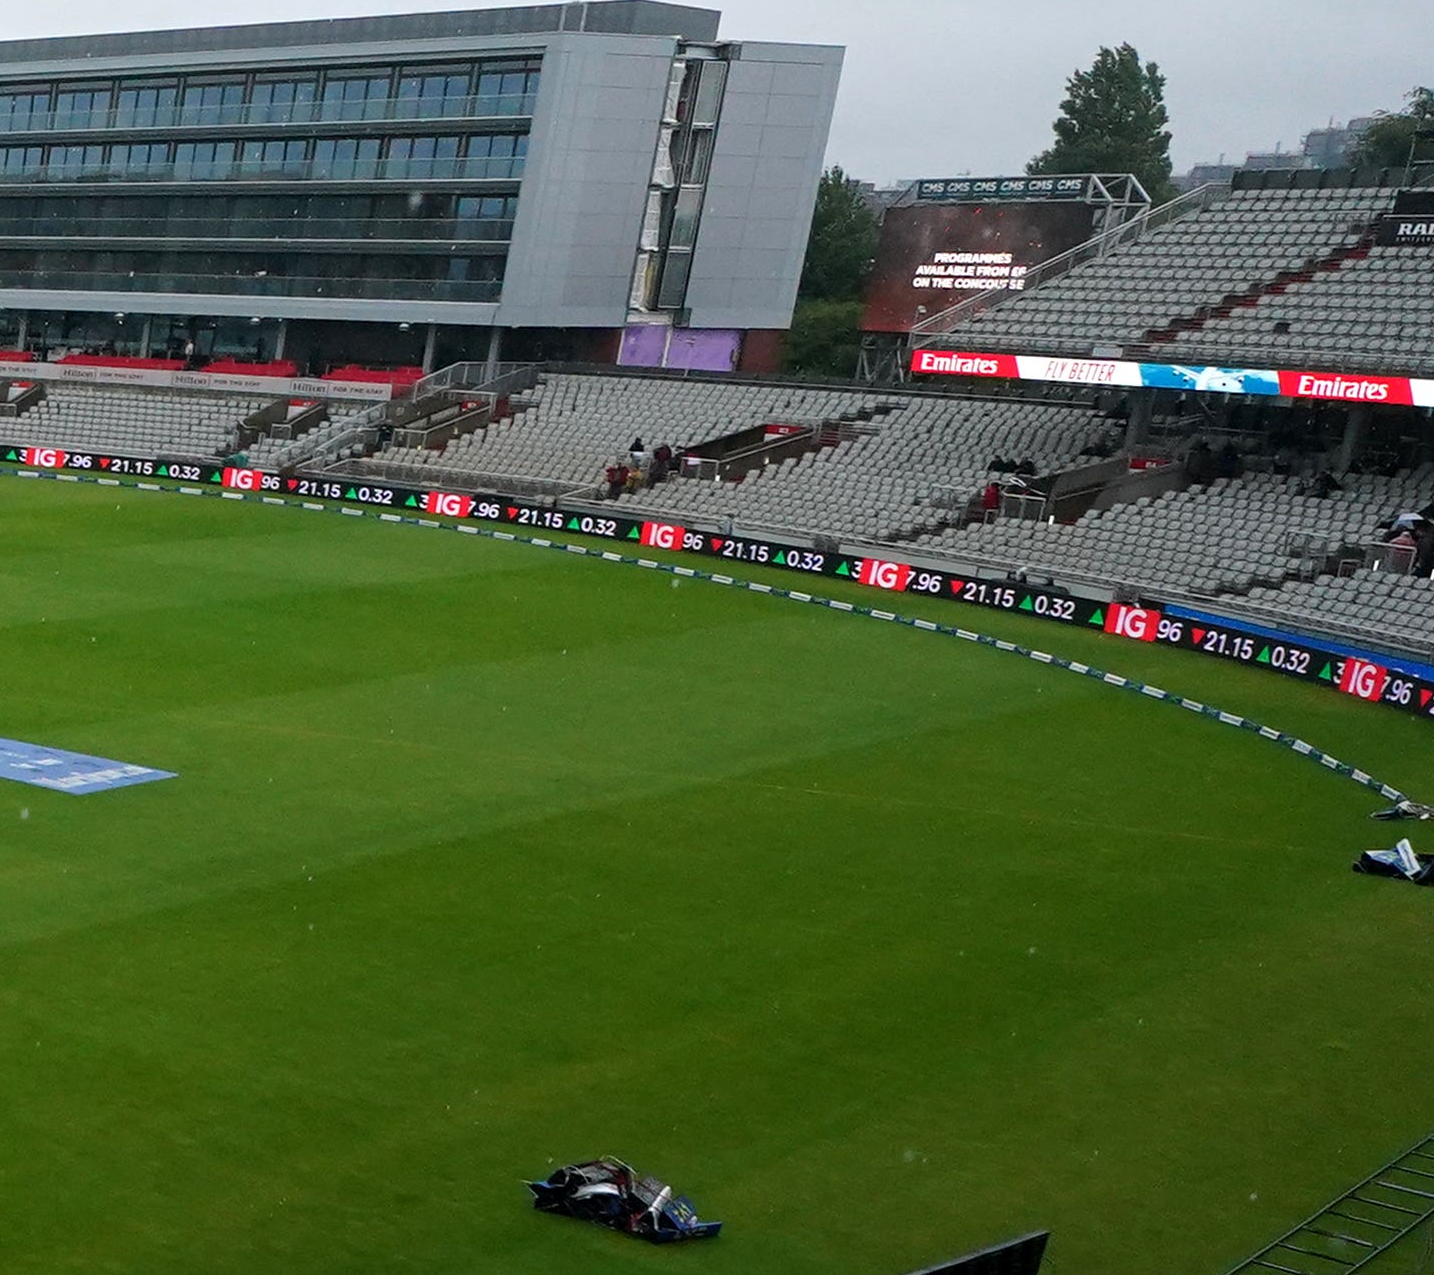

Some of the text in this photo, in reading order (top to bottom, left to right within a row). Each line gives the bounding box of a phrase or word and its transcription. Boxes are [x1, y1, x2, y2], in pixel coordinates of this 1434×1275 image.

[922, 179, 1082, 193] CMS CMS CMS CMS CMS CMS
[915, 265, 974, 275] AVAILABLE
[976, 265, 1007, 276] FROM
[934, 253, 1012, 264] PROGRAMMES
[913, 277, 930, 288] ON
[932, 278, 953, 288] THE
[921, 356, 1115, 382] Emirates FLY BETTER
[1298, 375, 1388, 399] Emirates
[34, 449, 56, 467] IG
[110, 458, 153, 475] 21.15
[168, 464, 200, 481] 0.32
[230, 469, 393, 504] IG 96 21.15 0.32
[436, 493, 461, 516] IG
[518, 508, 563, 528] 21.15
[581, 517, 617, 537] 0.32
[650, 525, 825, 572] IG 96 21.15 0.32
[868, 560, 898, 588] IG
[963, 583, 1015, 608] 21.15
[1034, 595, 1076, 620] 0.32
[1115, 606, 1311, 674] IG 96 21.15 0.32
[1348, 662, 1377, 697] IG
